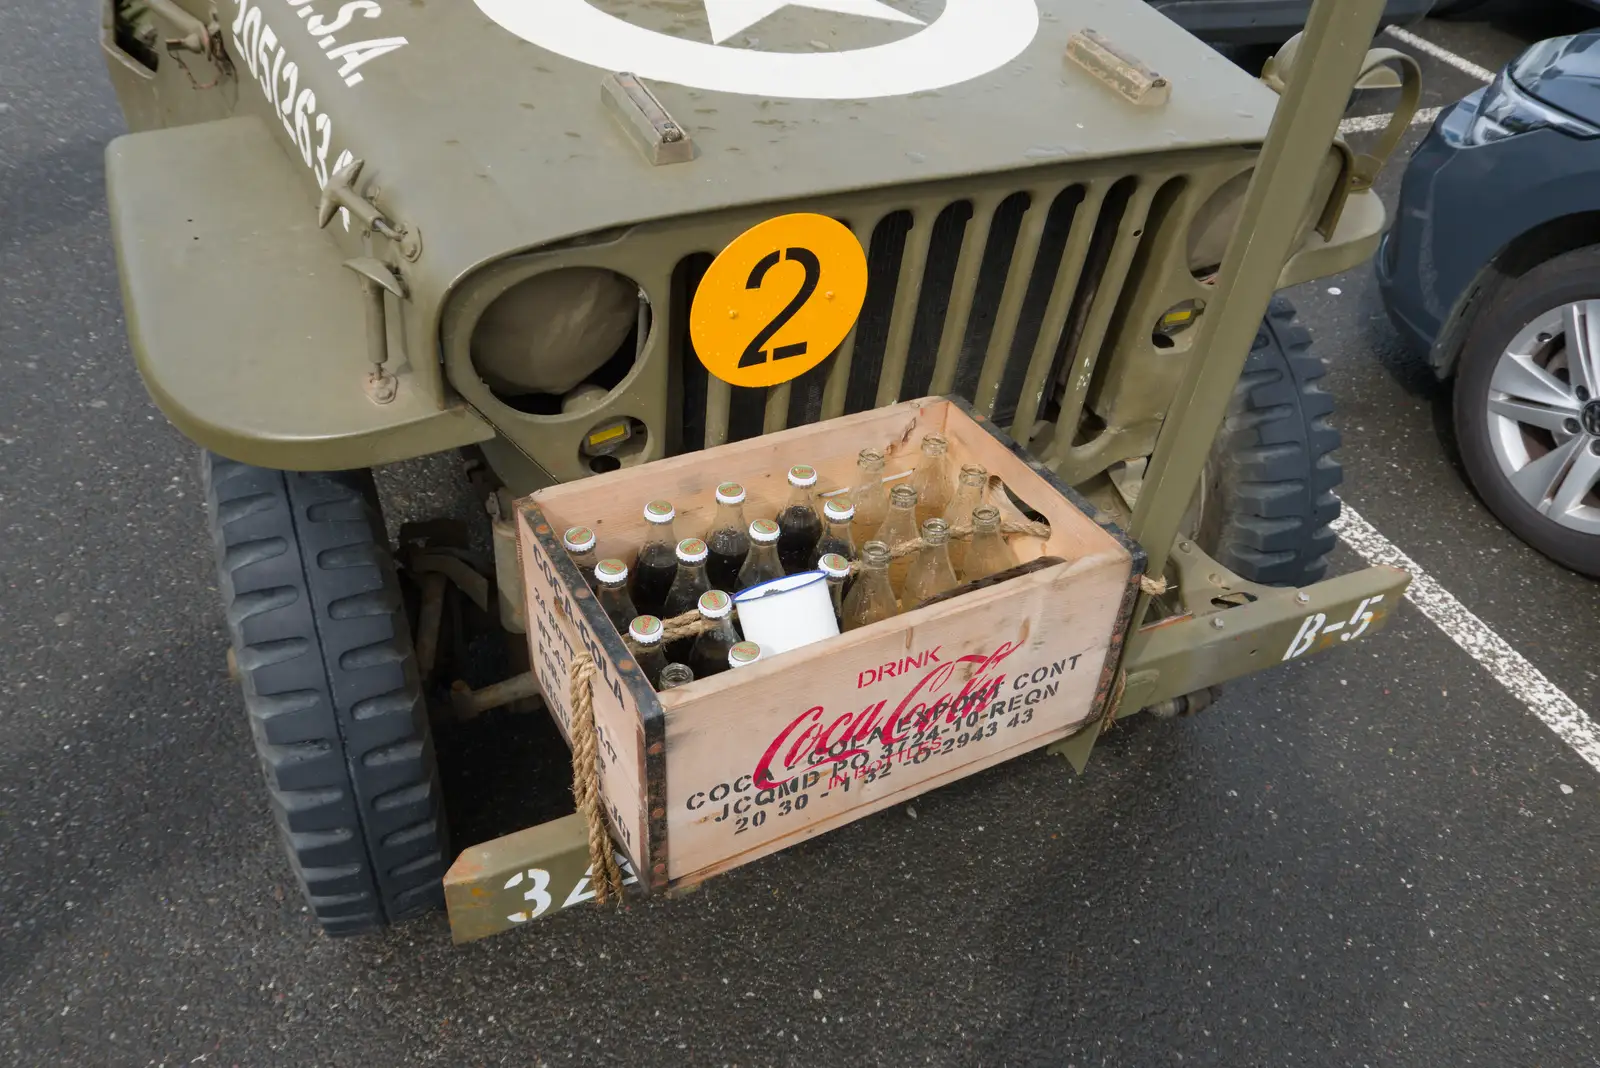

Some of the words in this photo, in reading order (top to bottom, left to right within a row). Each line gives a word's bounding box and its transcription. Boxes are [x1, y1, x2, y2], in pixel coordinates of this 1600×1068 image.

[286, 0, 409, 88] .S.A.
[738, 247, 821, 369] 2
[533, 543, 625, 712] COCA-COLA
[857, 645, 943, 689] DRINK
[1281, 594, 1384, 661] B-5
[1013, 653, 1083, 691] CONT
[734, 810, 766, 835] 20
[778, 794, 809, 816] 30
[1007, 708, 1034, 728] 43
